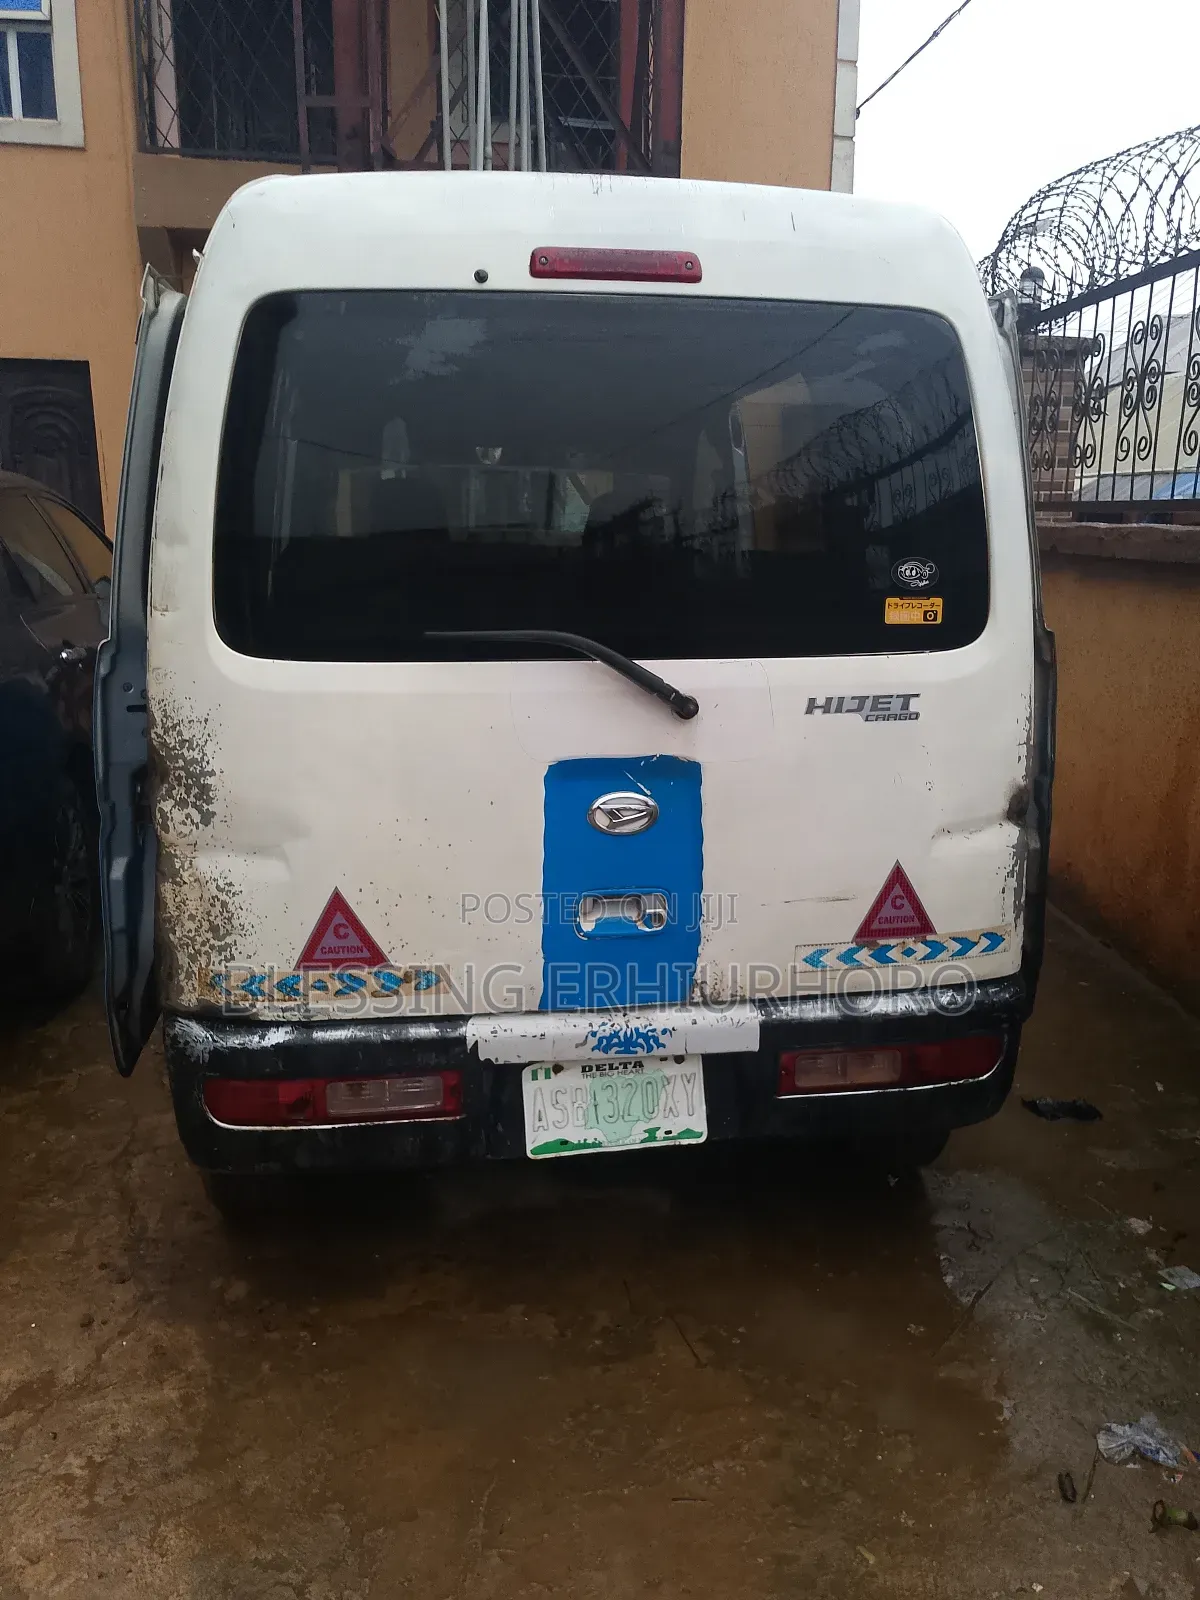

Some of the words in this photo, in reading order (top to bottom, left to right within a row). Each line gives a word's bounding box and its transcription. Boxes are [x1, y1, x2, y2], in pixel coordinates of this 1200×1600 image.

[805, 693, 921, 715] HIJET
[864, 712, 921, 722] CARGO
[890, 894, 905, 911] C
[878, 915, 915, 925] CAUTION
[332, 923, 350, 941] C
[320, 945, 364, 956] CAUTION
[581, 1060, 645, 1074] DELTA
[581, 1072, 596, 1080] THE
[600, 1070, 615, 1078] BIG
[617, 1067, 645, 1076] HEART
